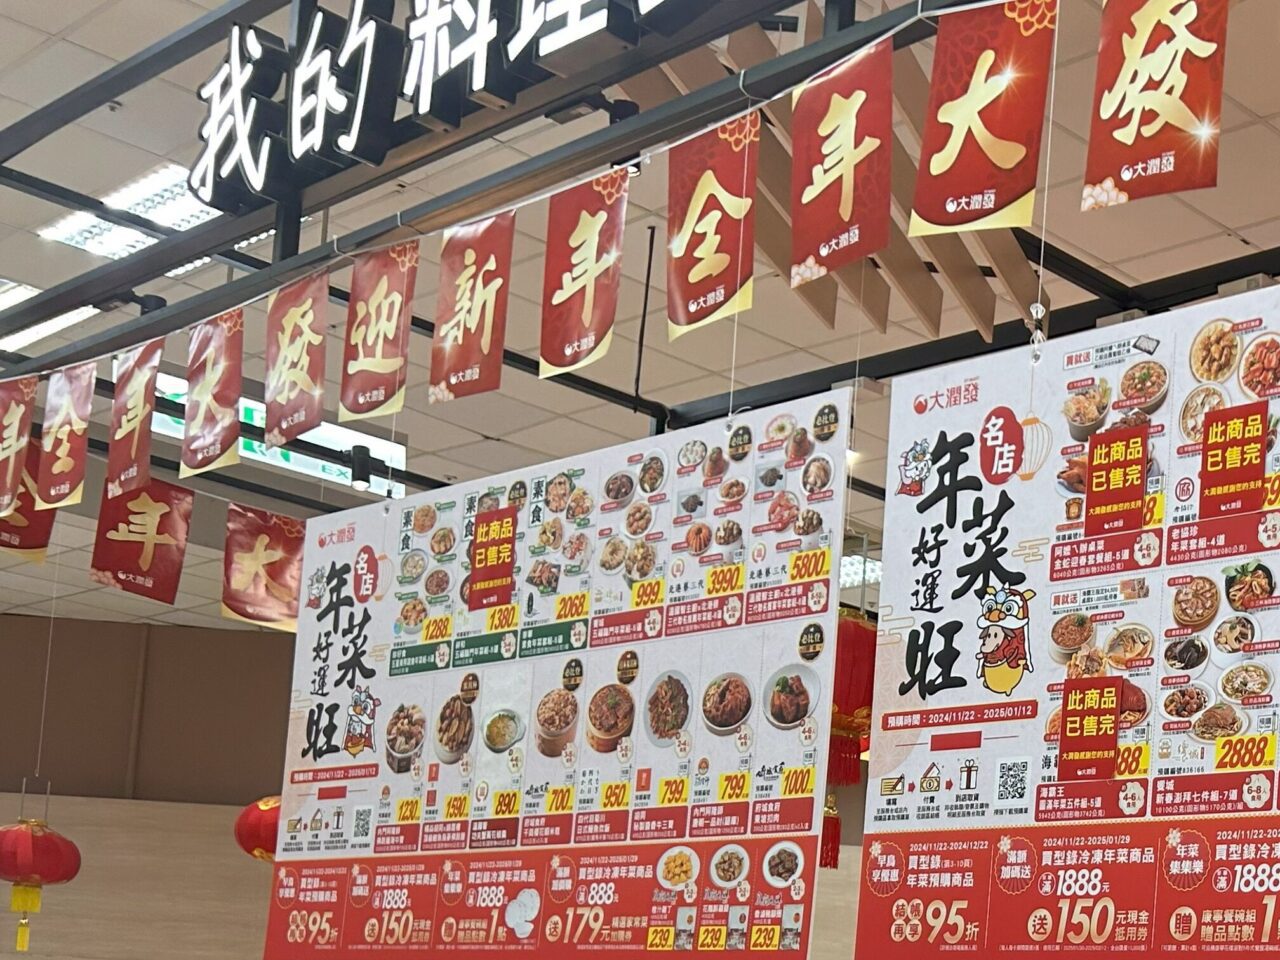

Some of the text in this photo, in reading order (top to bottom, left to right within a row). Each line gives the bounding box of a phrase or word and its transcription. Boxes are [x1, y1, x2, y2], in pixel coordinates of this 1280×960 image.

[930, 50, 1027, 175] 大
[801, 89, 881, 221] 年
[1133, 152, 1175, 177] 大潤發
[958, 190, 995, 212] 大潤發
[670, 169, 752, 285] 全
[828, 226, 860, 254] 大潤發
[552, 209, 619, 324] 年
[440, 248, 503, 355] 新
[348, 275, 405, 375] 迎
[929, 381, 980, 411] 大潤發
[1208, 415, 1262, 444] 此商品
[983, 416, 1016, 475] 名店
[1092, 437, 1143, 465] 此商品
[1207, 443, 1261, 471] 已售完
[1092, 465, 1142, 492] 已售完
[106, 492, 178, 571] 年
[476, 518, 513, 543] 此商品
[475, 544, 511, 568] 已售完
[791, 551, 825, 579] 5800
[635, 581, 661, 606] 999
[708, 566, 741, 595] 3990
[490, 608, 515, 630] 1380
[557, 594, 585, 619] 2068
[425, 618, 449, 640] 1288
[1067, 687, 1116, 710] 此商品
[1066, 715, 1115, 736] 已售完
[1217, 736, 1268, 770] 2888
[663, 779, 685, 803] 799
[783, 769, 809, 793] 1000
[1041, 848, 1154, 866] 買型錄冷凍年菜商品
[1056, 898, 1115, 944] 150
